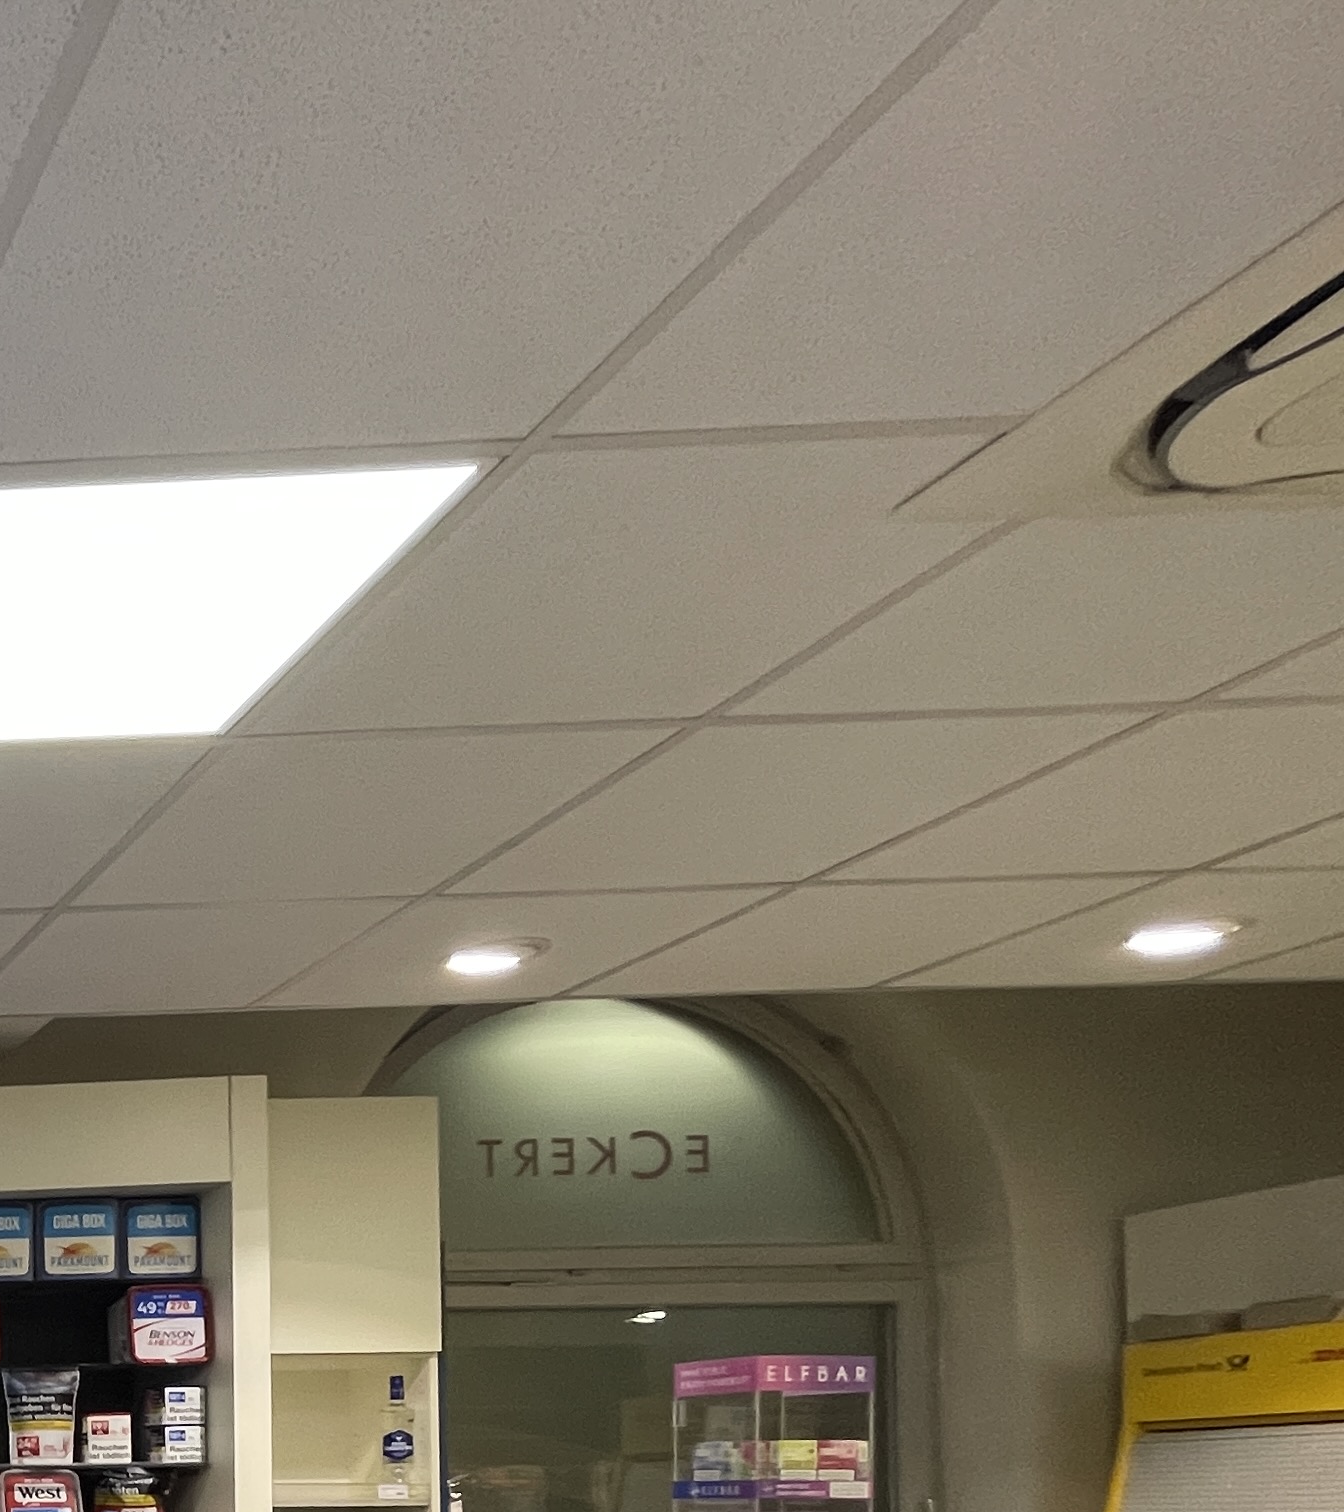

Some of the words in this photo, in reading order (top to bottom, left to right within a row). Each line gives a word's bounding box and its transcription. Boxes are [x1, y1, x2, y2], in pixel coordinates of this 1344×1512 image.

[148, 1329, 195, 1340] BENSON
[767, 1365, 868, 1382] ELFBAR
[18, 1486, 62, 1501] West
